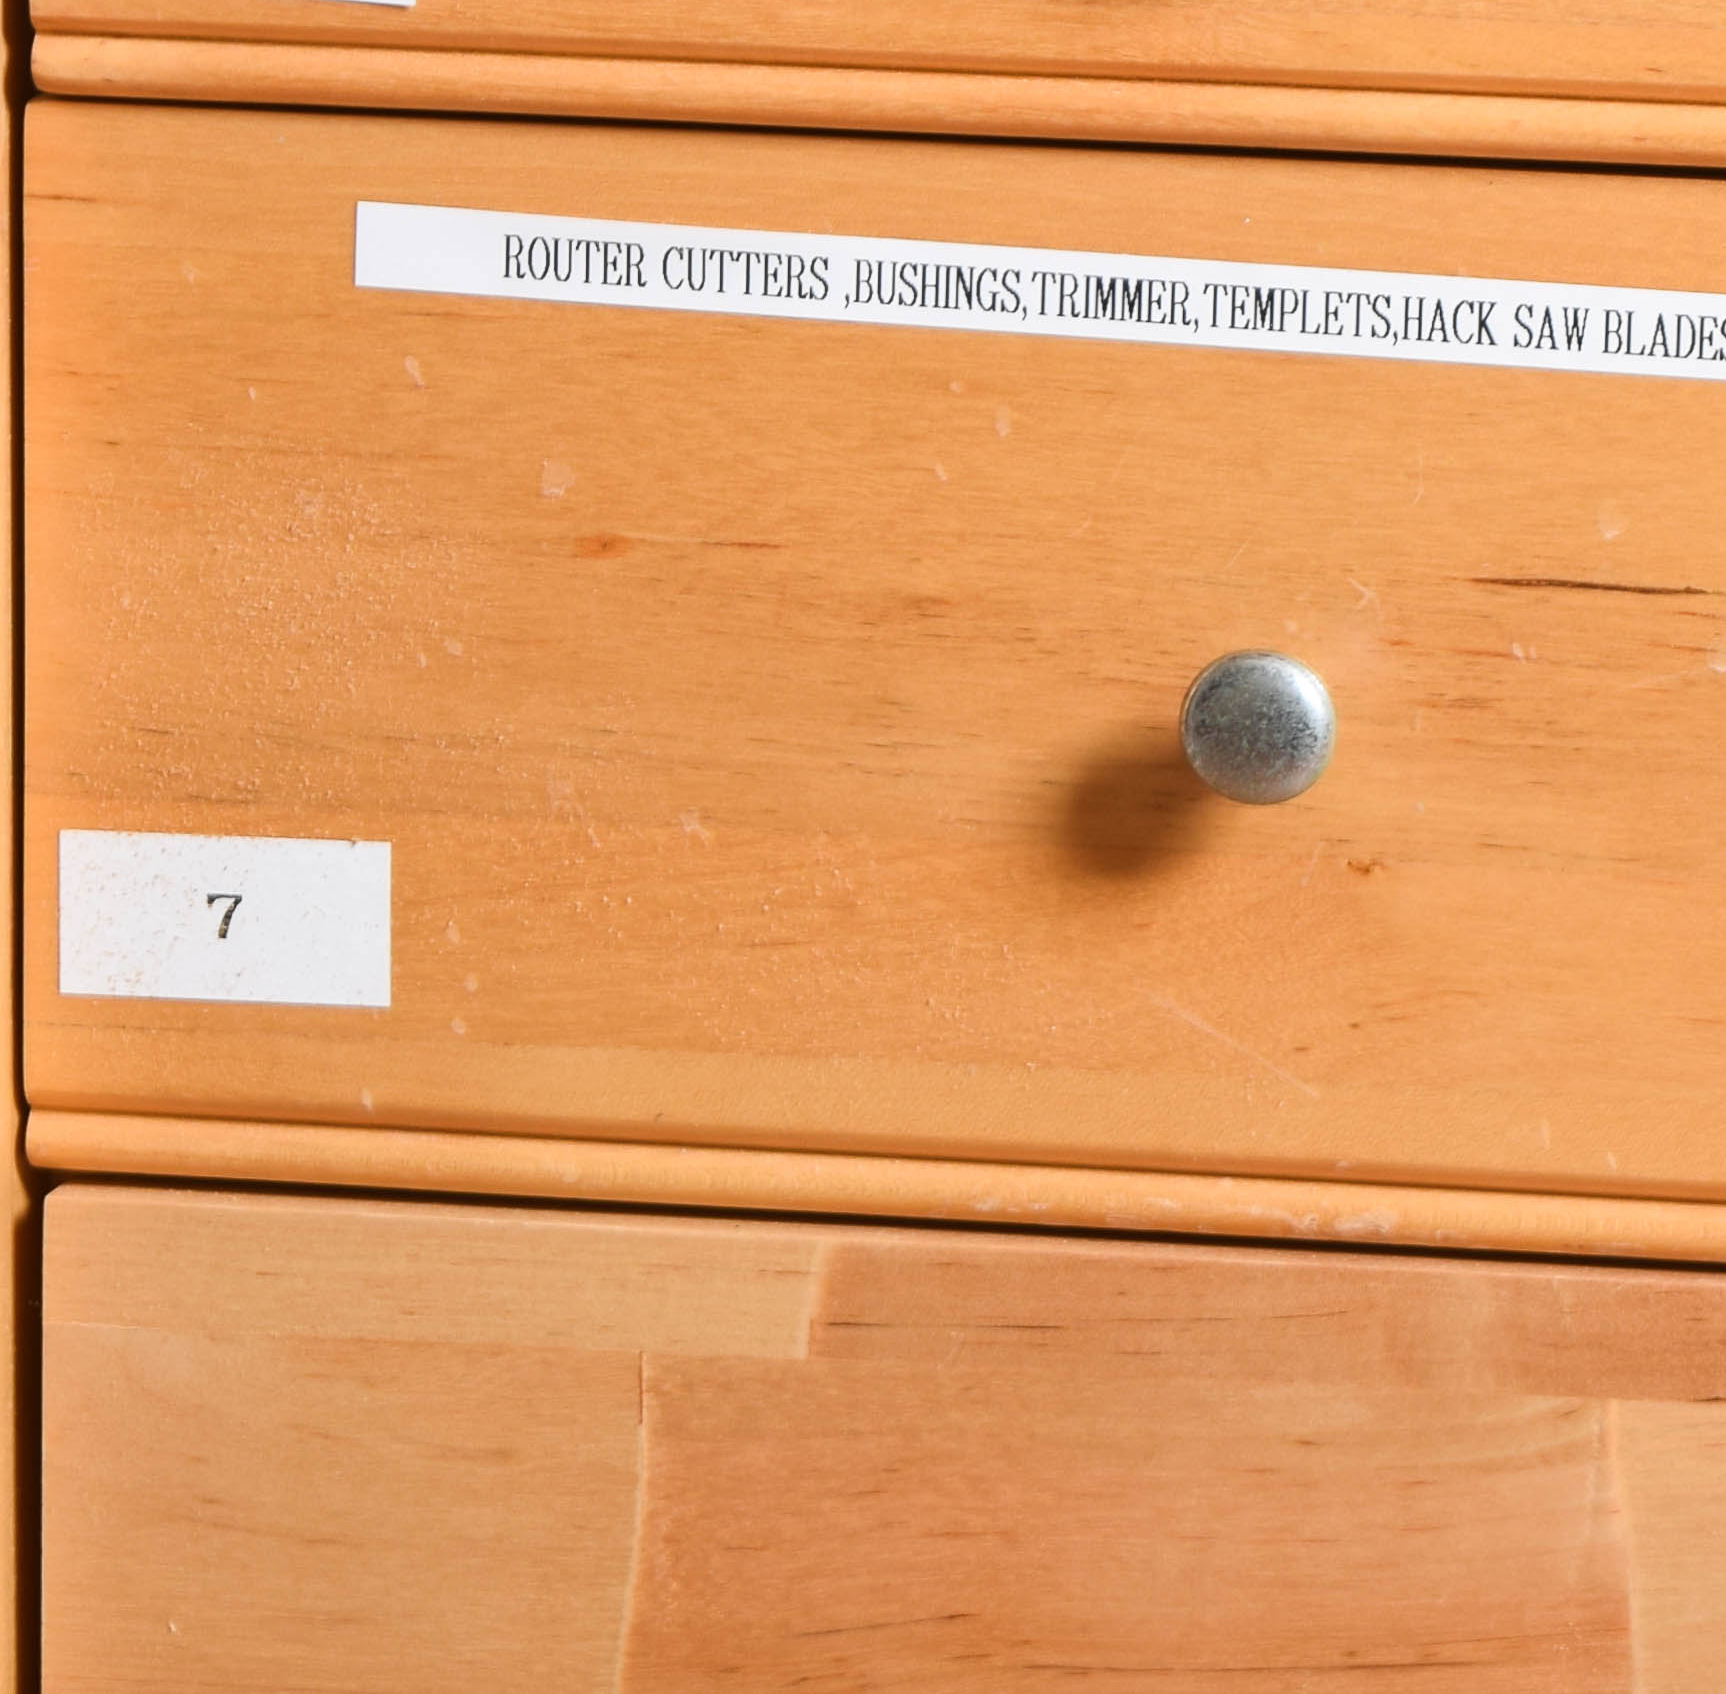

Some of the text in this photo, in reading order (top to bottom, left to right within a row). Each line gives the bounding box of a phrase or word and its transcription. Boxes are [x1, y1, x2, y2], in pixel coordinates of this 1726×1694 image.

[503, 234, 647, 288] ROUTER
[662, 246, 829, 301] CUTTERS
[1513, 304, 1590, 352] SAW
[206, 893, 243, 939] 7
